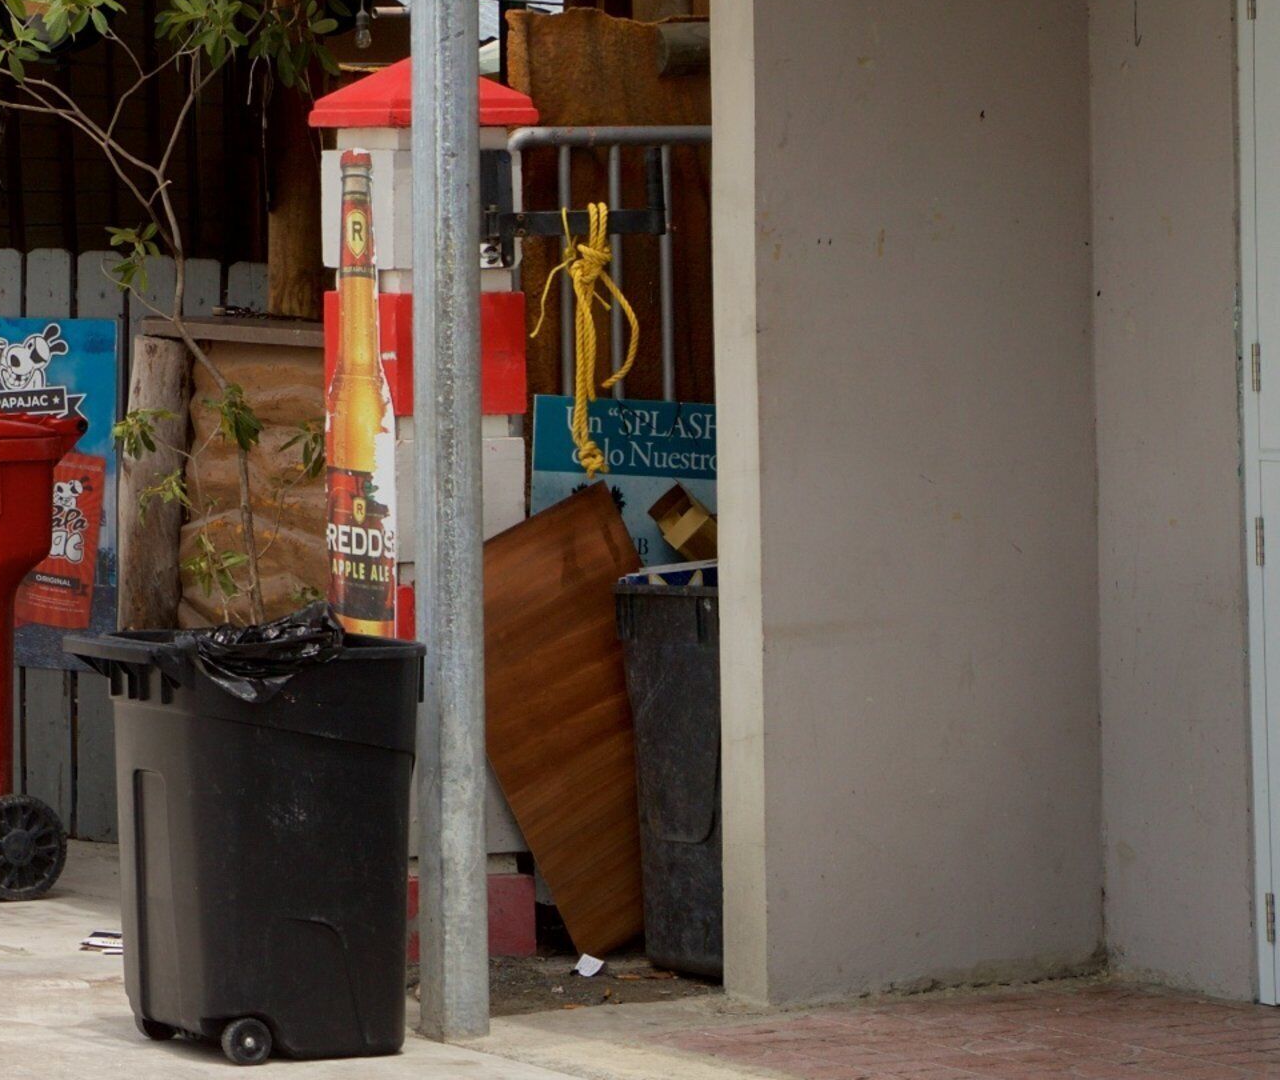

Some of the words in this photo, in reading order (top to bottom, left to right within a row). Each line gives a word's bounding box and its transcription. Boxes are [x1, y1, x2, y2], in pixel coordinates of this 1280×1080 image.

[351, 220, 363, 241] R
[357, 503, 364, 515] R
[332, 558, 366, 580] APPLE
[371, 564, 390, 582] ALE
[35, 574, 71, 587] ORIGINAL
